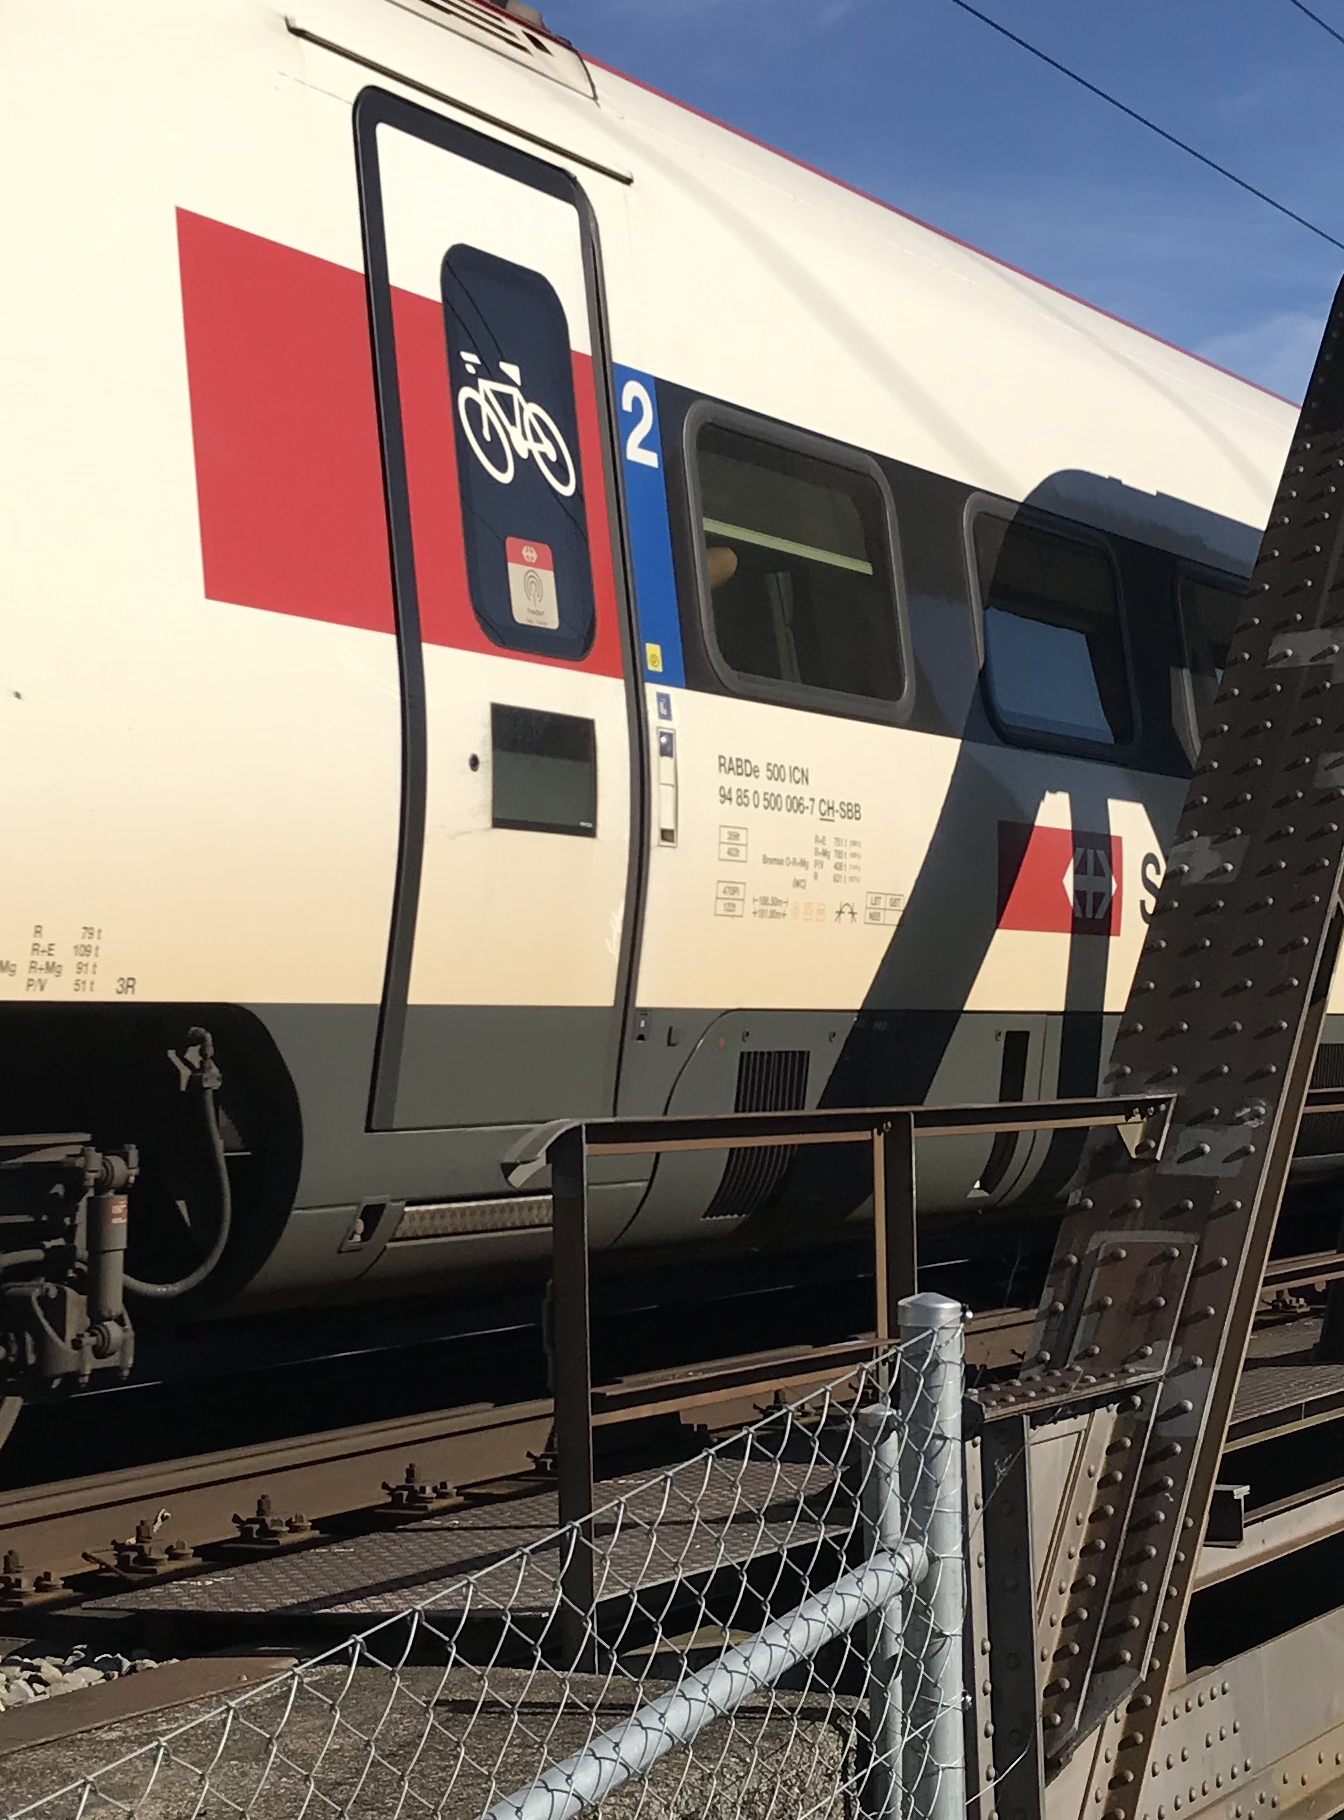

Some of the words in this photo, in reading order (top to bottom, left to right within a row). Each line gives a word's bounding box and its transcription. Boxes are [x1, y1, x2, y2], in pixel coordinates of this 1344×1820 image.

[622, 380, 659, 468] 2
[718, 754, 760, 779] RABDe
[766, 762, 786, 783] 500
[789, 765, 809, 786] ICN
[719, 785, 733, 805] 94
[736, 788, 750, 807] 85
[753, 790, 760, 809] 0
[763, 791, 783, 812] 500
[786, 794, 815, 815] 006-7
[819, 798, 862, 822] CH-SBB
[1140, 852, 1161, 925] S
[33, 925, 43, 938] R
[81, 926, 95, 940] 79
[31, 942, 55, 956] R+E
[73, 944, 92, 957] 109
[28, 960, 63, 977] R+Mg
[76, 961, 89, 975] 91
[73, 979, 86, 992] 51
[116, 977, 136, 995] 3R
